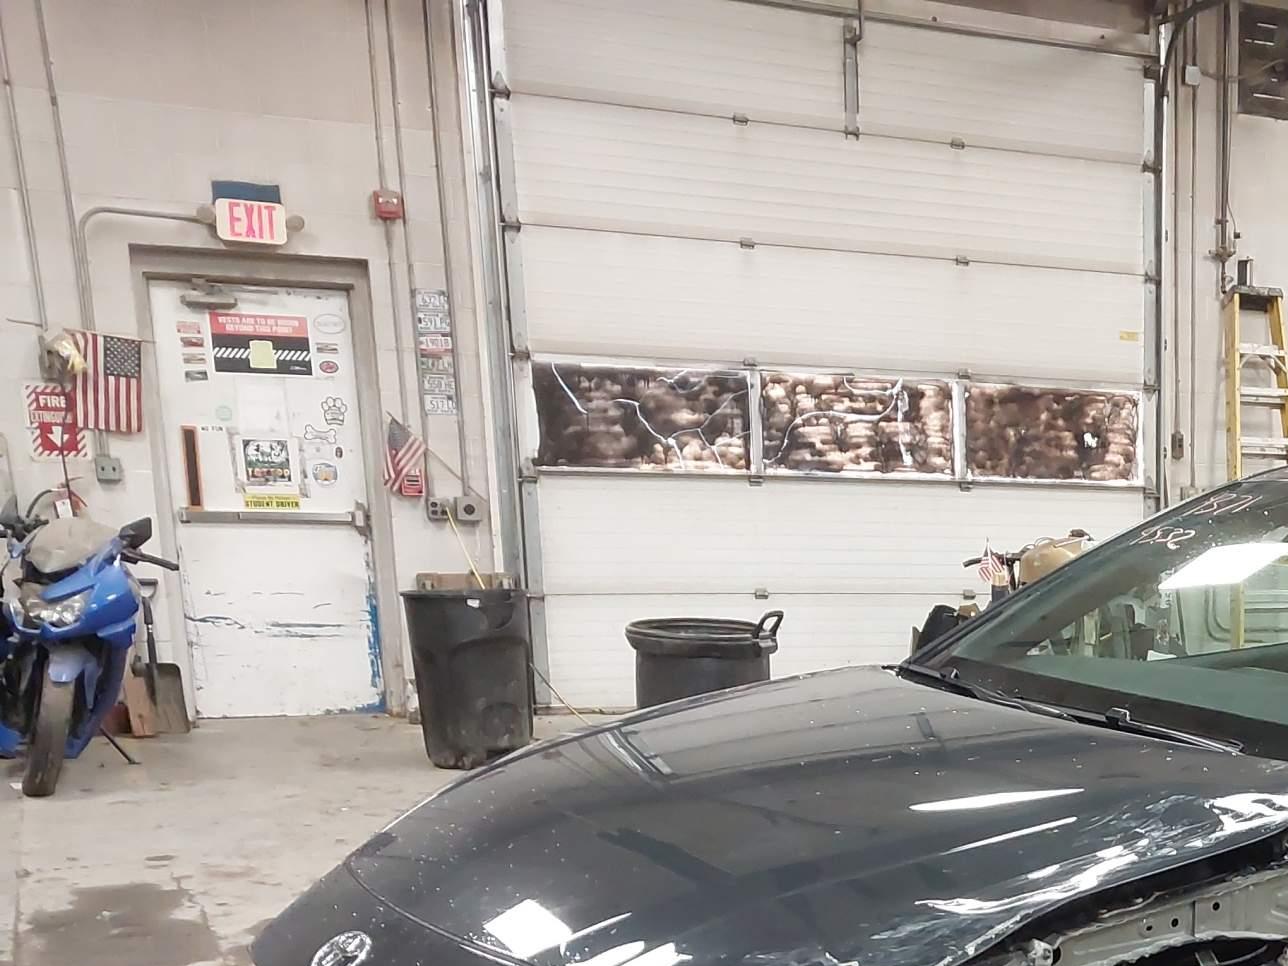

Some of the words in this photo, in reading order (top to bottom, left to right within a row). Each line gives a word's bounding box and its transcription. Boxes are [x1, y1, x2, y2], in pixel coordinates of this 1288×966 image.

[228, 201, 276, 240] EXIT
[39, 395, 66, 408] FIRE
[276, 500, 299, 508] DRIVER
